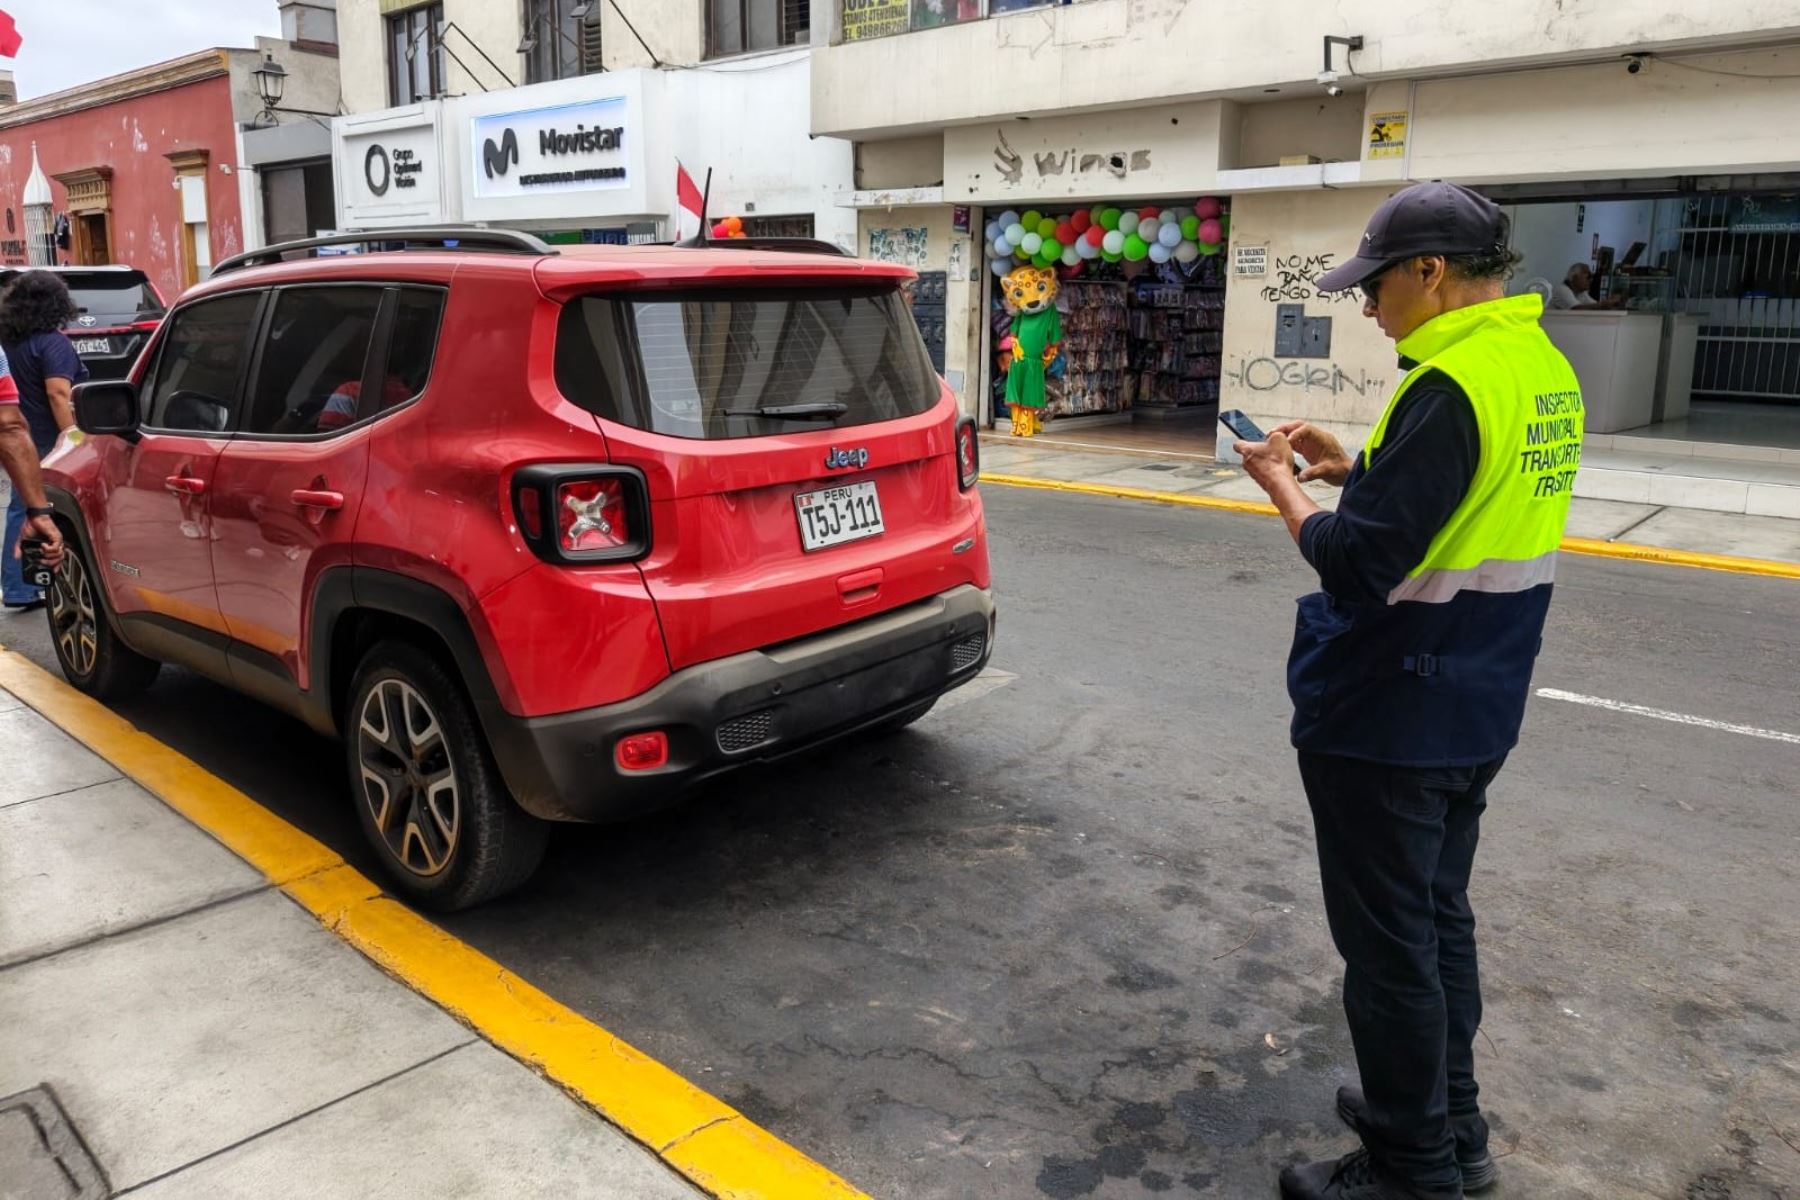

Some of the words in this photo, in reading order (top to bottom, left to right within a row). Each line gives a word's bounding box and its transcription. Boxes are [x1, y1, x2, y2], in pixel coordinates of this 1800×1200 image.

[539, 123, 624, 156] Movistar
[1276, 255, 1301, 269] NO
[1304, 253, 1335, 270] ME
[1261, 286, 1311, 302] TENGO
[826, 447, 869, 468] Jeep
[824, 487, 853, 503] PERU
[802, 494, 881, 540] T5J-111
